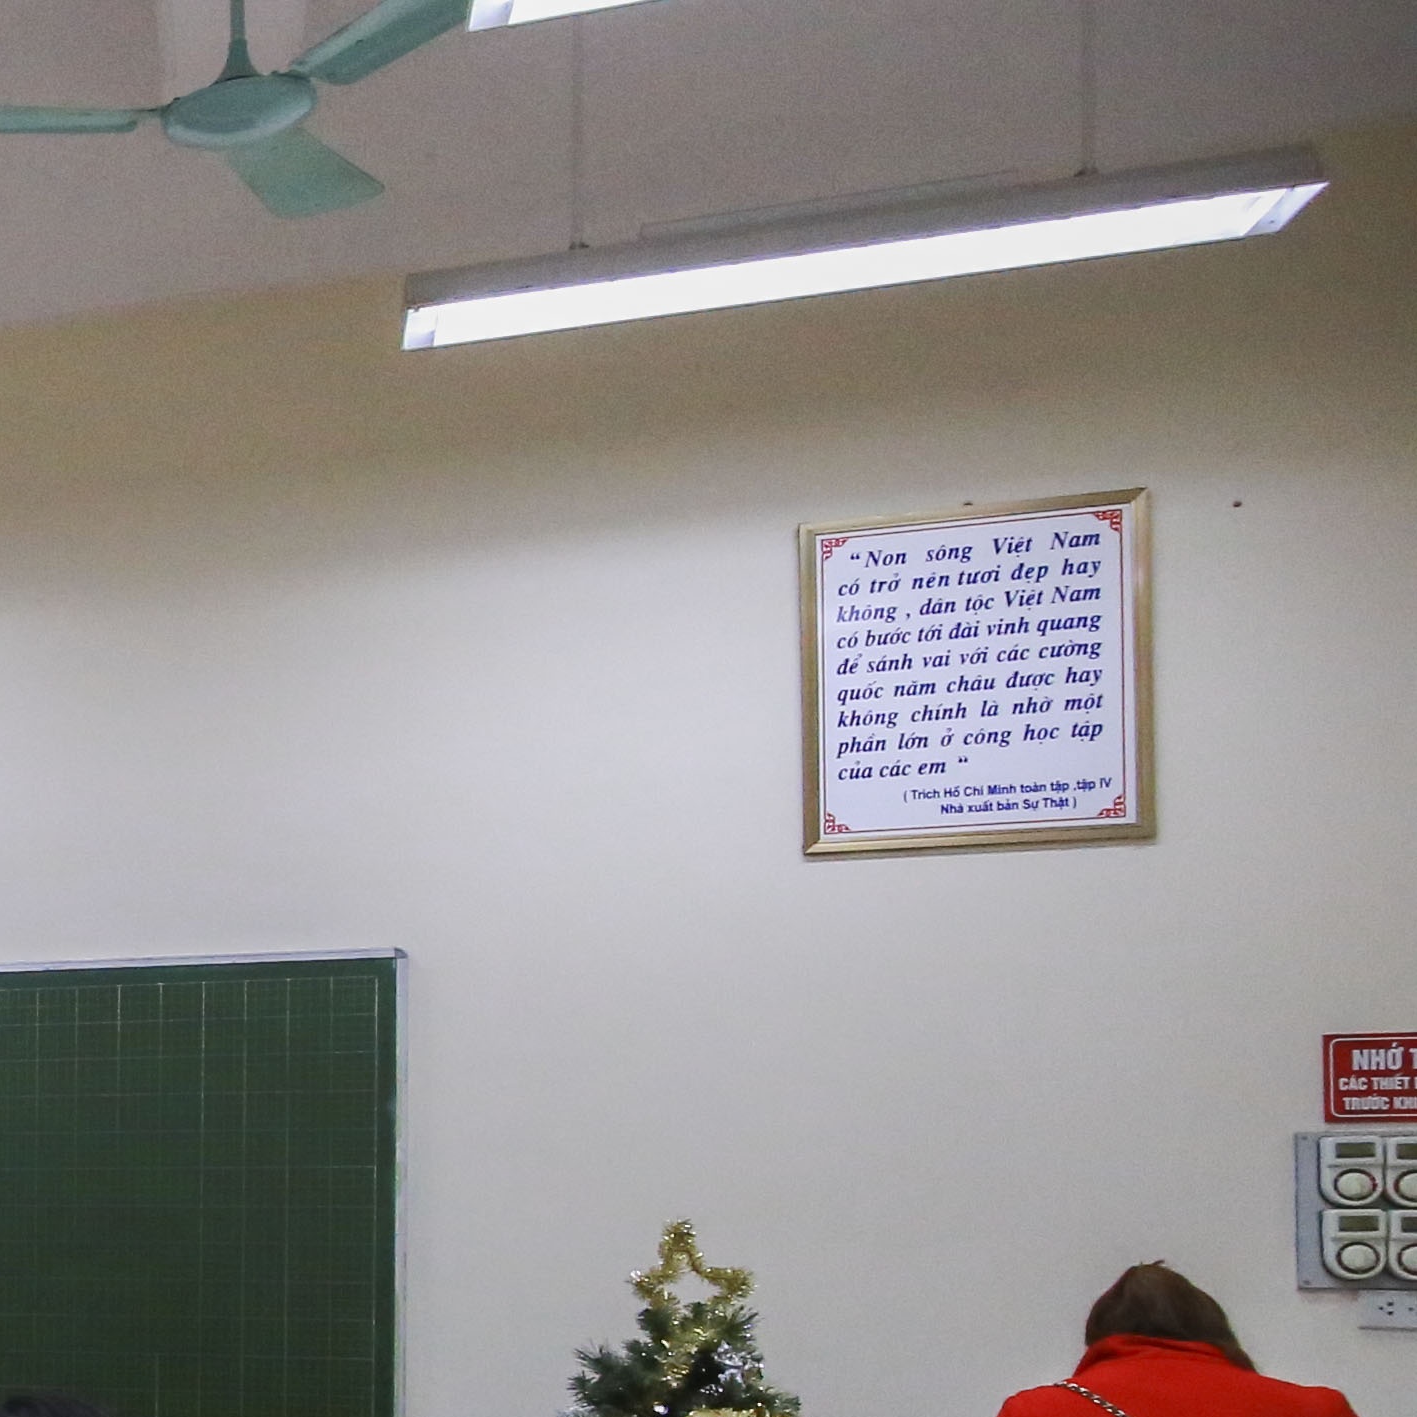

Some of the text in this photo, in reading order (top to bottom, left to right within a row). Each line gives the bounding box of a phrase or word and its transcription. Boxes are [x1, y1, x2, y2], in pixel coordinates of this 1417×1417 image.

[925, 544, 973, 563] sông
[993, 536, 1033, 558] Việt
[1050, 531, 1100, 551] Nam
[838, 578, 860, 596] có
[869, 573, 901, 594] trở
[911, 572, 950, 590] nên
[957, 564, 1001, 586] tươi
[1061, 558, 1101, 578] hay
[836, 605, 898, 623] không
[919, 598, 956, 616] dân
[965, 594, 995, 615] tộc
[1004, 589, 1043, 611] Việt
[1050, 585, 1101, 604] Nam
[837, 631, 858, 649] có
[865, 627, 911, 647] bước
[917, 623, 943, 642] tới
[987, 616, 1029, 636] vinh
[1036, 614, 1102, 637] quang
[866, 653, 913, 673] sánh
[923, 649, 951, 668] vai
[960, 646, 989, 665] với
[996, 644, 1030, 663] các
[1038, 639, 1102, 660] cường
[837, 681, 884, 706] quốc
[893, 680, 936, 697] năm
[946, 674, 995, 692] châu
[1065, 666, 1103, 687] hay
[837, 693, 1103, 729] không chính là nhờ một
[836, 733, 886, 759] phần
[897, 732, 929, 750] lớn
[940, 727, 954, 748] ở
[1023, 723, 1060, 744] học
[1071, 720, 1103, 741] tập
[838, 760, 873, 781] của
[879, 760, 912, 778] các
[918, 761, 946, 775] em
[987, 784, 1015, 796] Minh
[1099, 777, 1112, 789] IV
[1352, 1042, 1405, 1071] NHỚ
[1338, 1074, 1369, 1091] CÁC
